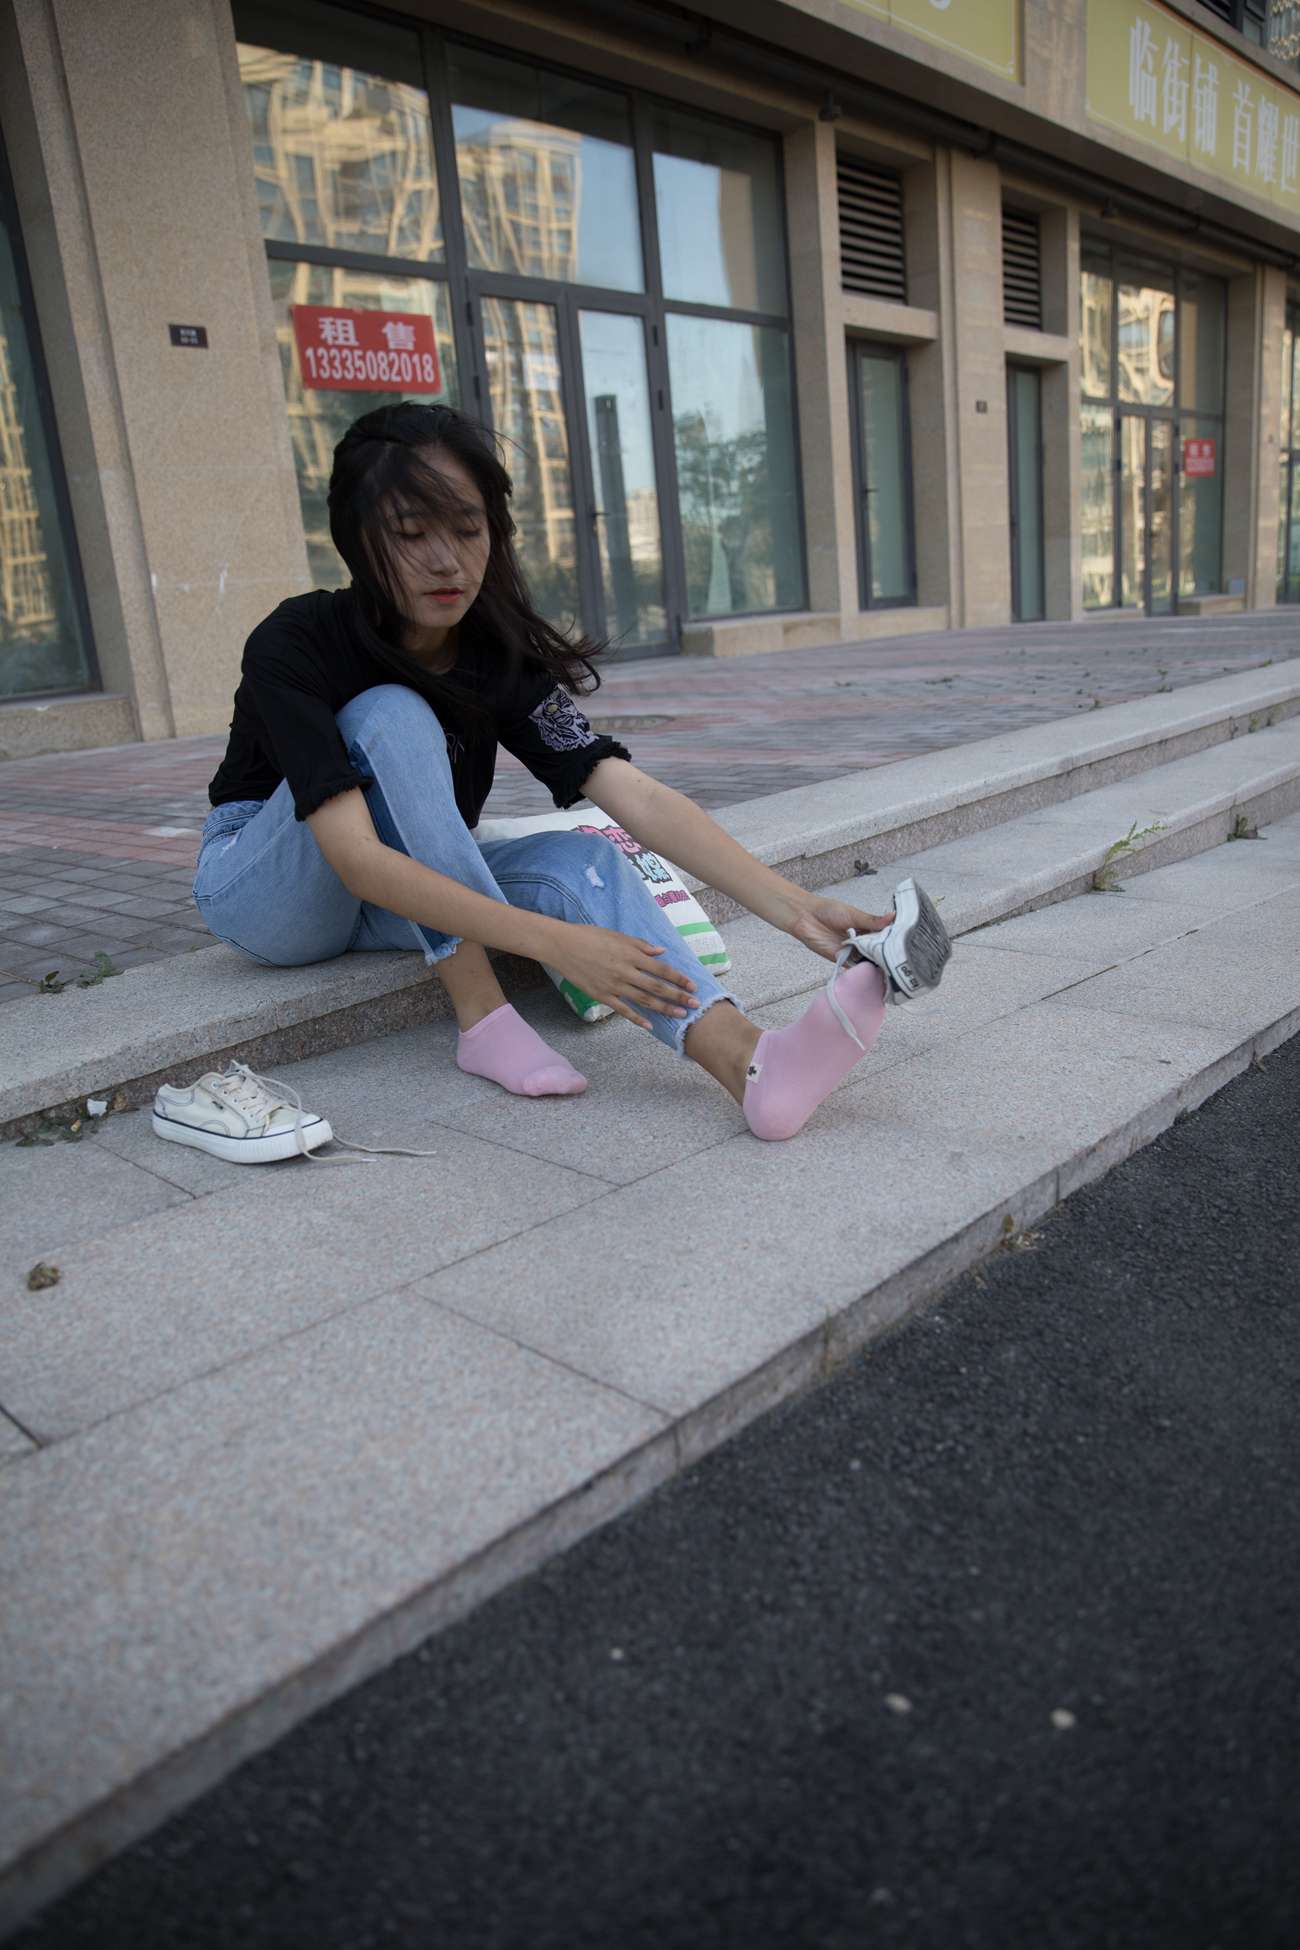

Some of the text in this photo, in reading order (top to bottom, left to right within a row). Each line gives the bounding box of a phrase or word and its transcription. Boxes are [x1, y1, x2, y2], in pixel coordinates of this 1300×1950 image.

[1128, 15, 1219, 158] 临街铺
[305, 346, 435, 383] 13335082018
